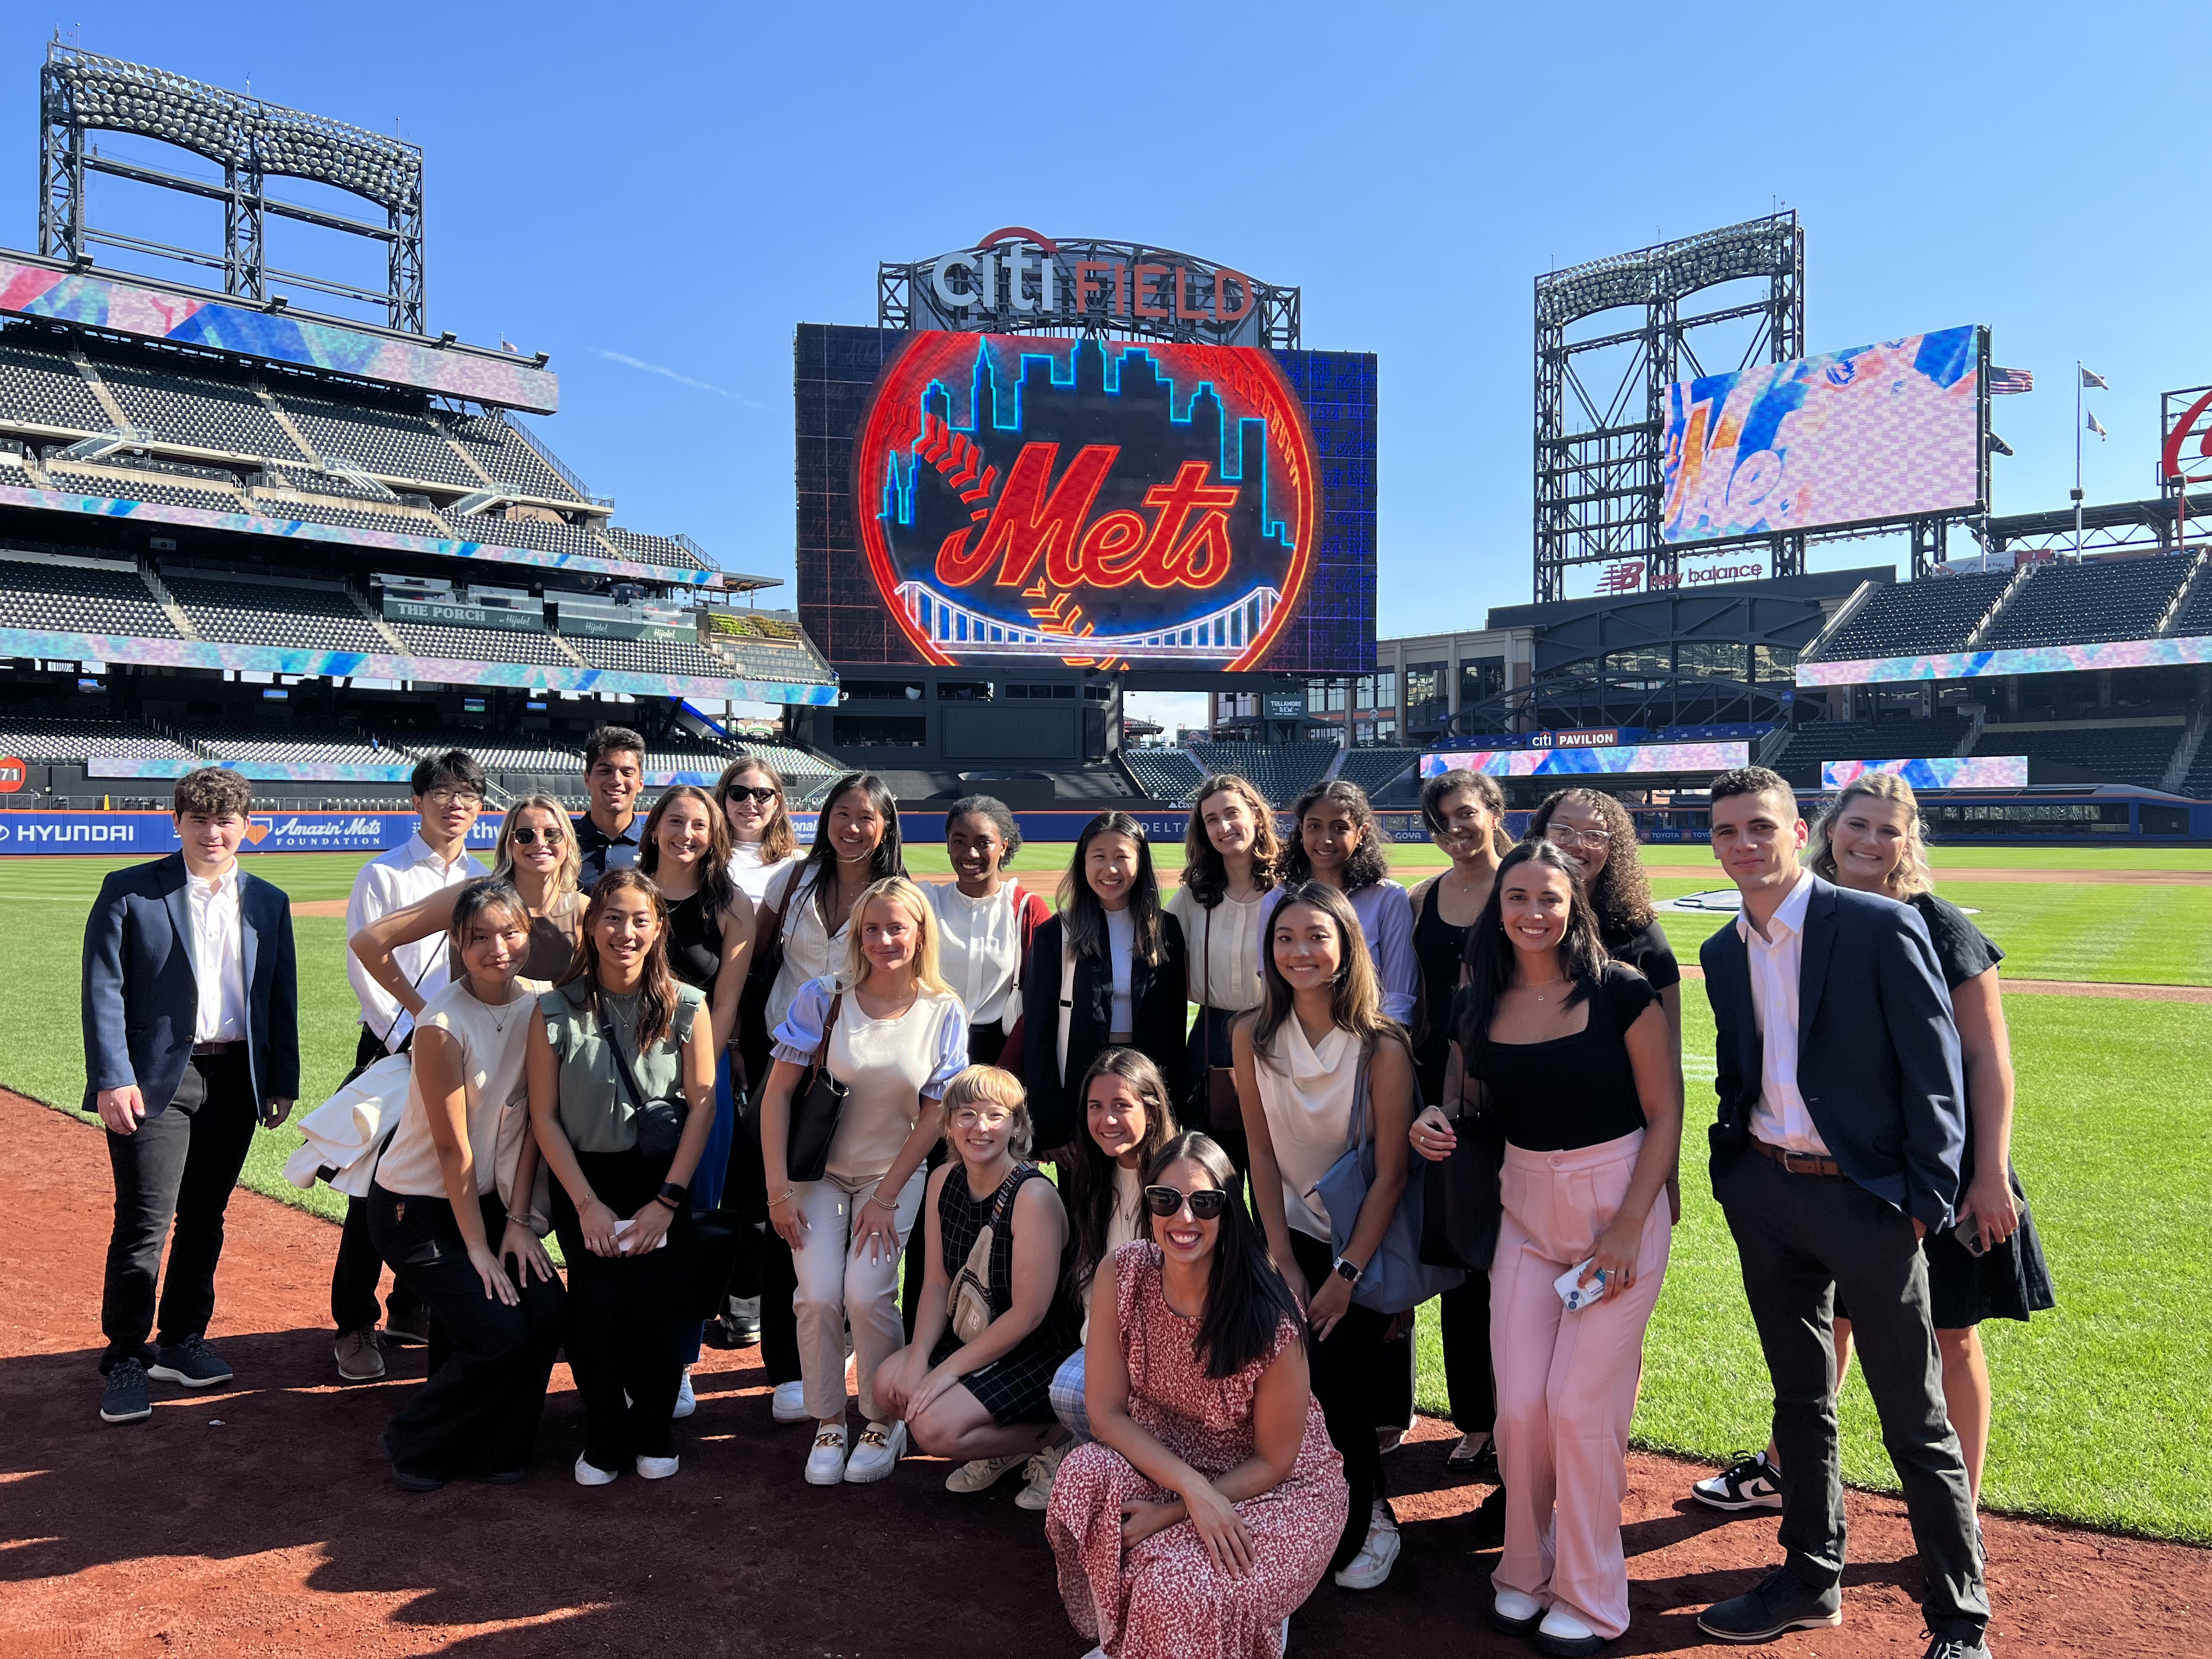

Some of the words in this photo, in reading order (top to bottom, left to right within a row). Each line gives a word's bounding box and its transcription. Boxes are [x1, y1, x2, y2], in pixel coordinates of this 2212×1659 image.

[933, 241, 1054, 312] citi
[1075, 260, 1254, 321] FIELD
[935, 442, 1241, 590] Mets
[1689, 563, 1763, 583] balance
[398, 603, 428, 617] THE
[433, 607, 486, 622] PORCH
[1532, 733, 1551, 747] citi
[1559, 733, 1613, 746] PAVILION
[1177, 800, 1195, 809] Coor
[18, 825, 134, 842] HYUNDAI
[275, 817, 345, 836] Amazin'
[344, 817, 381, 836] Mets
[276, 837, 380, 846] FOUNDATION
[1395, 832, 1421, 840] GOYA
